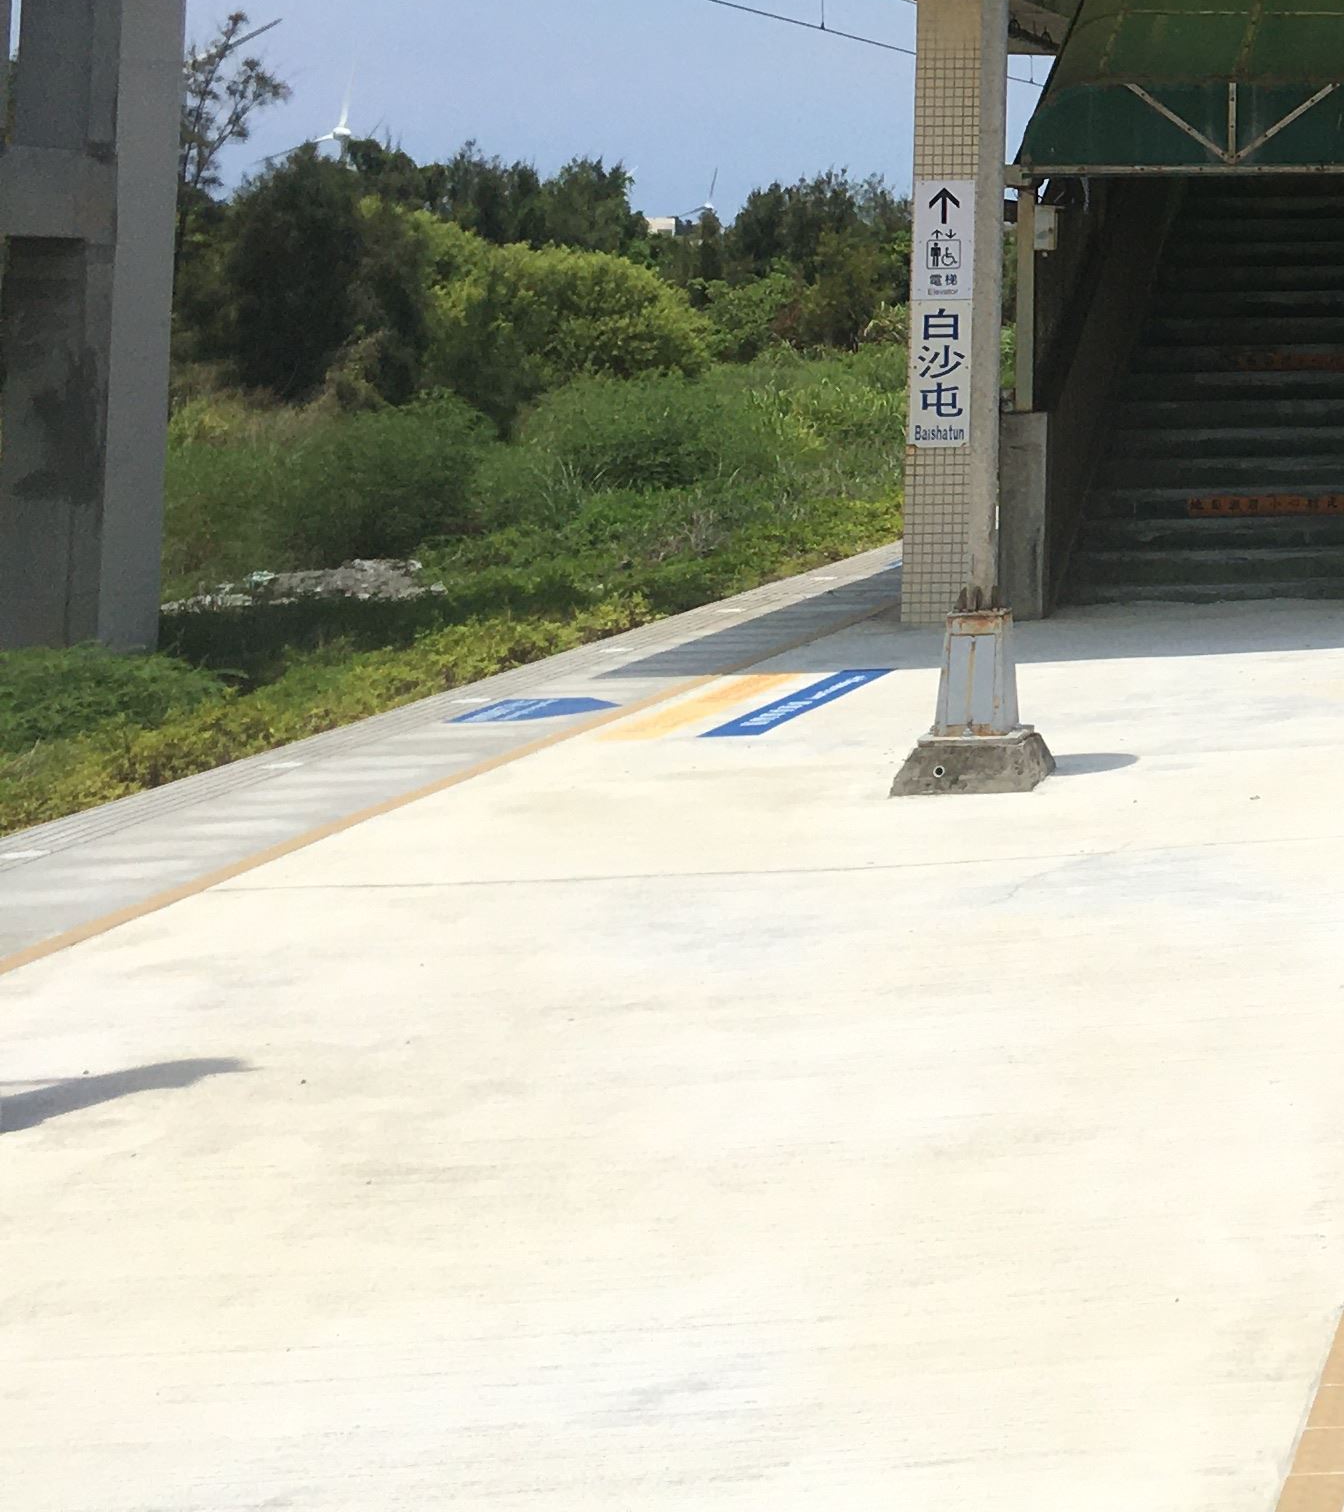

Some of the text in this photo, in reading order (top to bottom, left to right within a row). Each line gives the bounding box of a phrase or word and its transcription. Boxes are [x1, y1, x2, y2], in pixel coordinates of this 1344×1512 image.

[929, 273, 958, 286] 電梯
[918, 307, 965, 418] 白沙屯
[914, 424, 965, 442] Baishatun
